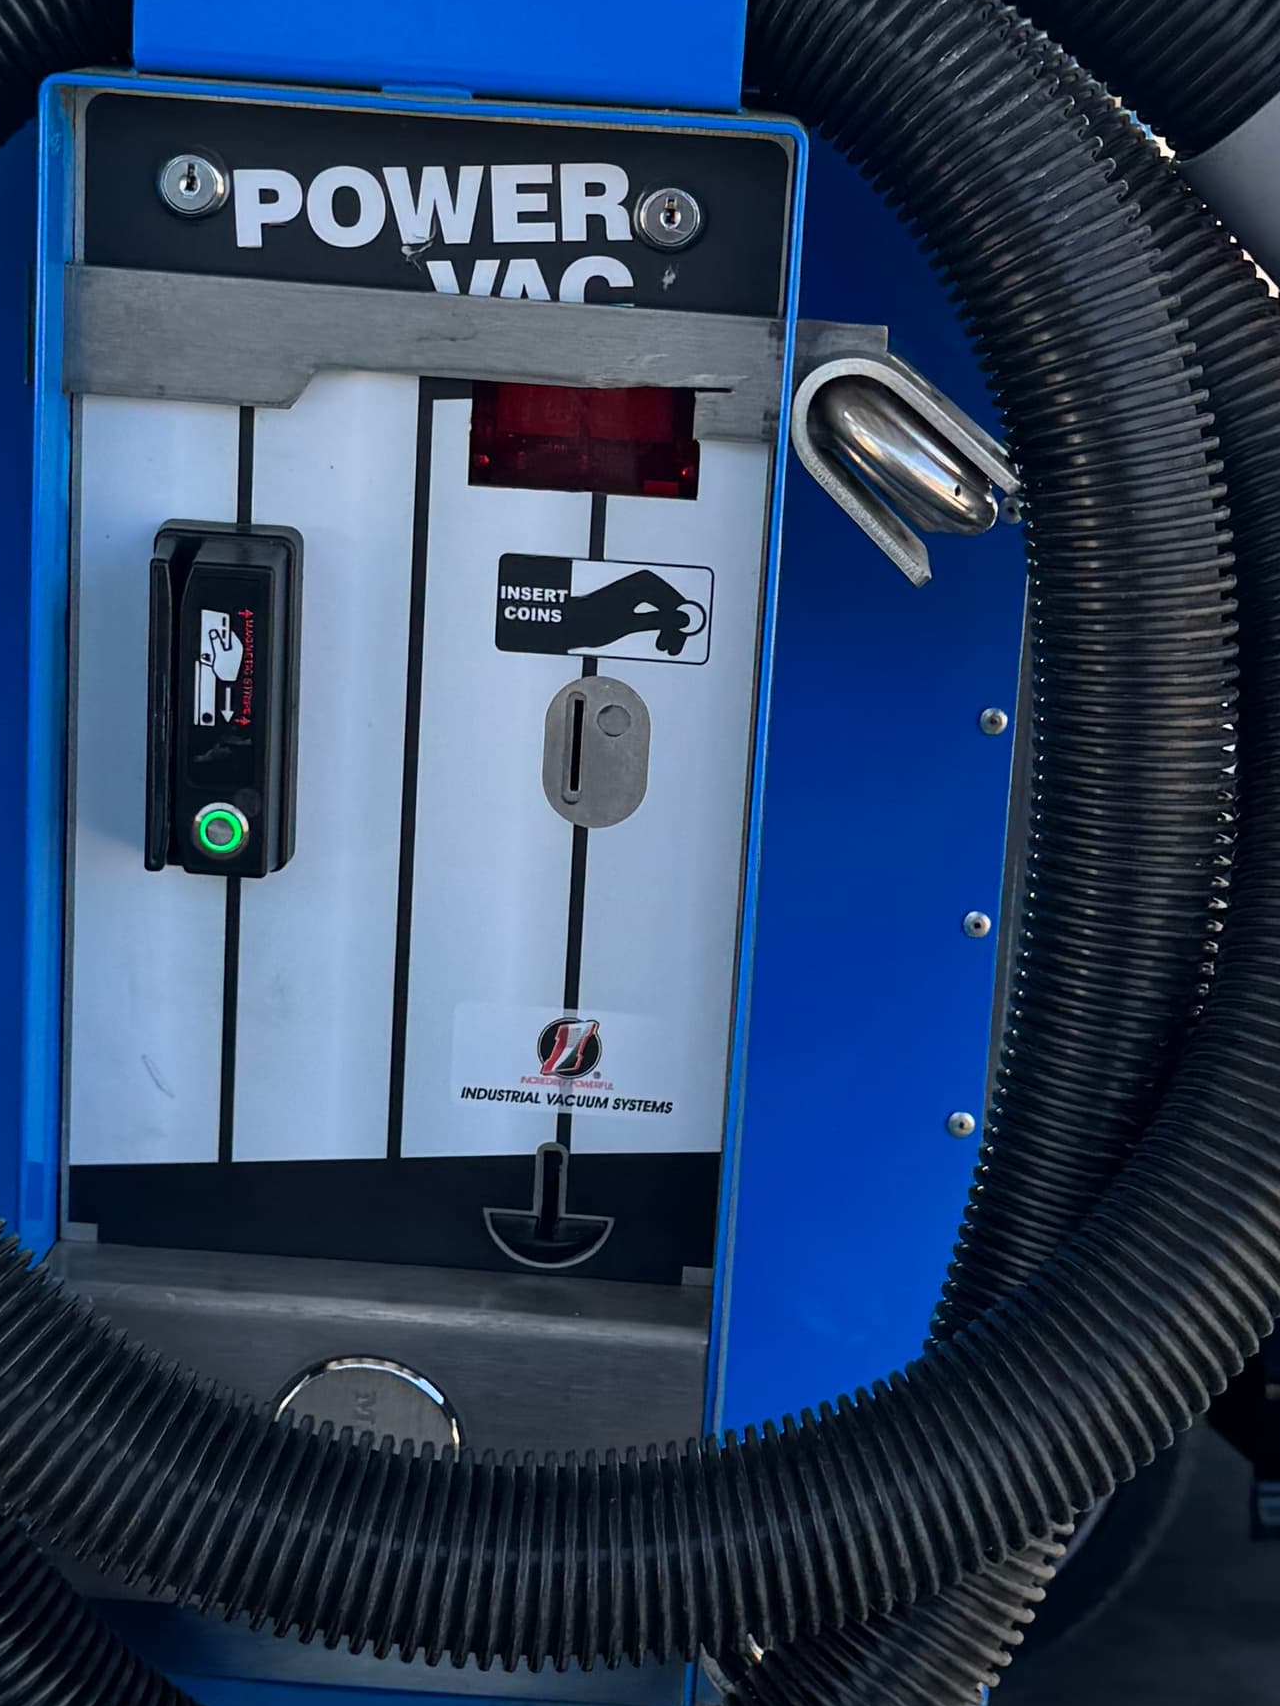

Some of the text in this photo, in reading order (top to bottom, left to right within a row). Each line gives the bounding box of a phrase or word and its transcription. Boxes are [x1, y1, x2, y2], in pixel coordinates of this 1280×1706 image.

[233, 163, 633, 248] POWER
[500, 585, 568, 603] INSERT
[504, 606, 562, 623] COINS
[461, 1086, 673, 1114] INDUSTRIAL VACUUM SYSTEMS
